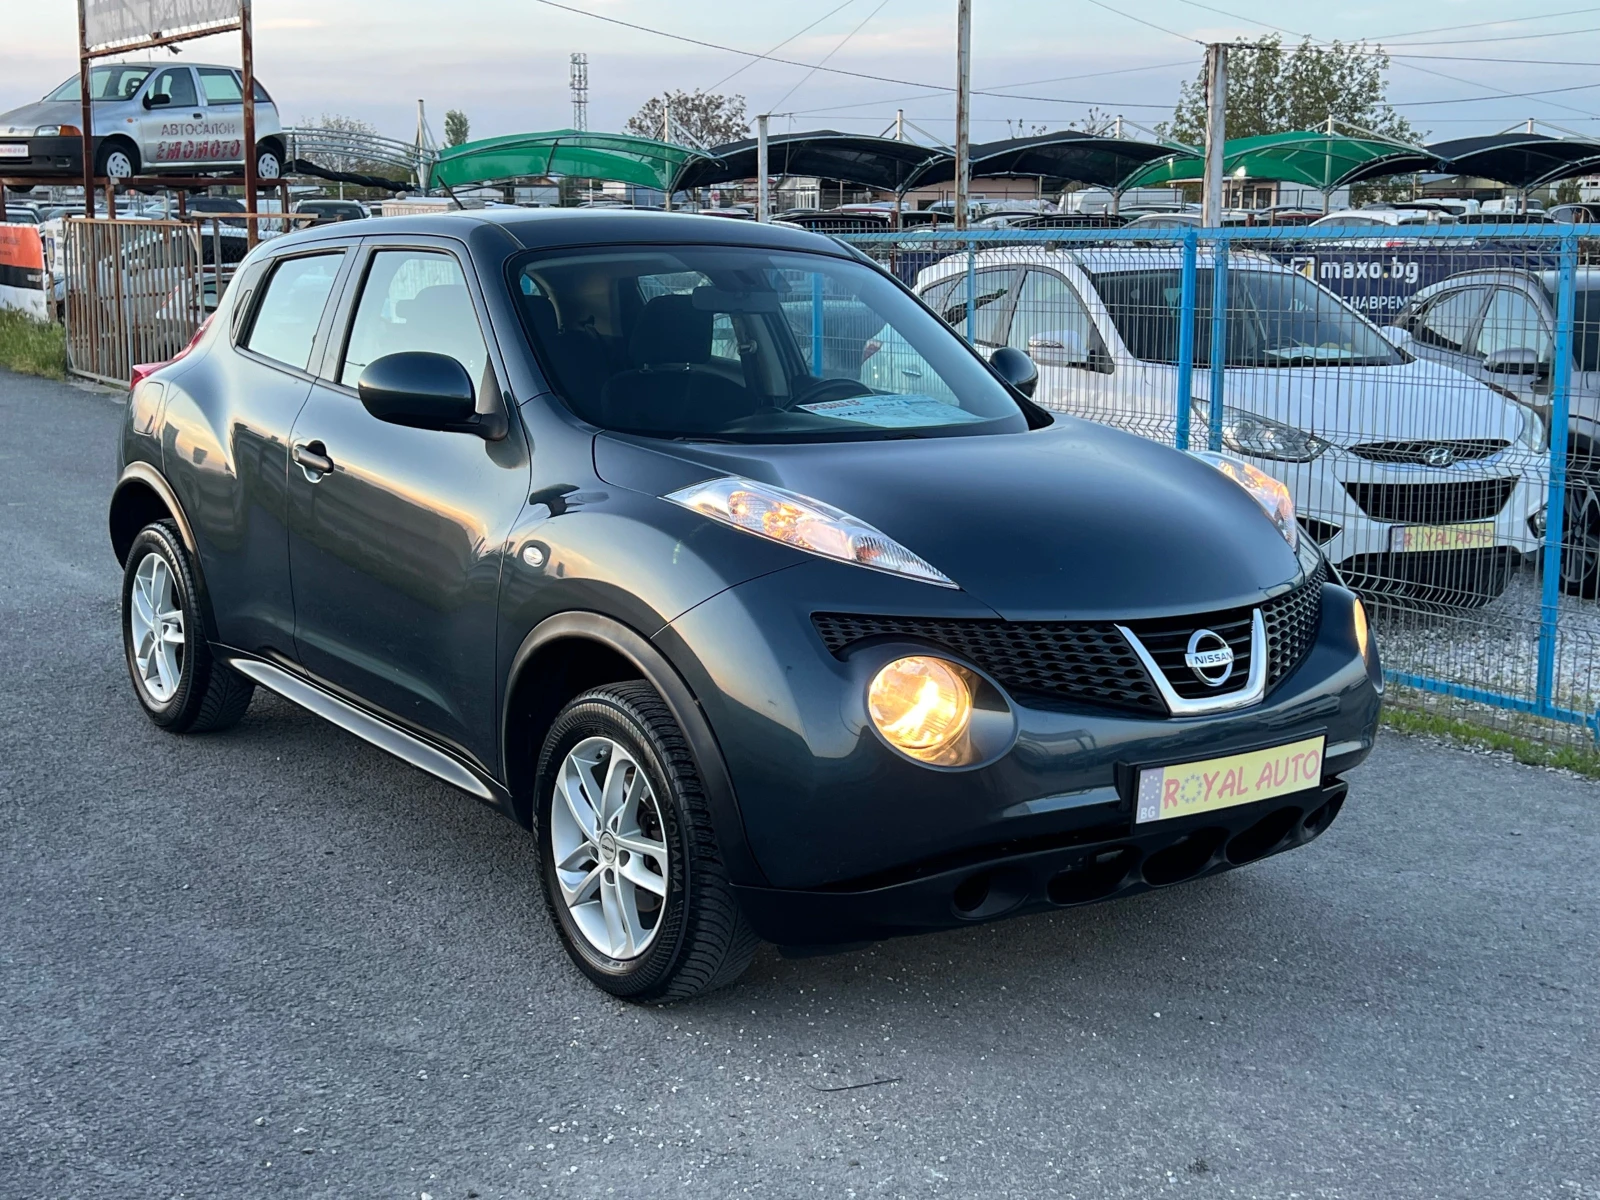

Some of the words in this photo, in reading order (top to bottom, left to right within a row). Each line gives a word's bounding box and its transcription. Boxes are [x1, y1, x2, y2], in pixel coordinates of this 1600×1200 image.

[161, 123, 236, 136] АВТОСАЛОН
[1320, 256, 1419, 284] maxo.bg
[1456, 524, 1492, 545] AUTO
[1194, 651, 1233, 665] NISSAN
[1163, 766, 1248, 809] ROYAL
[1255, 750, 1320, 791] AUTO
[1140, 806, 1156, 820] BG
